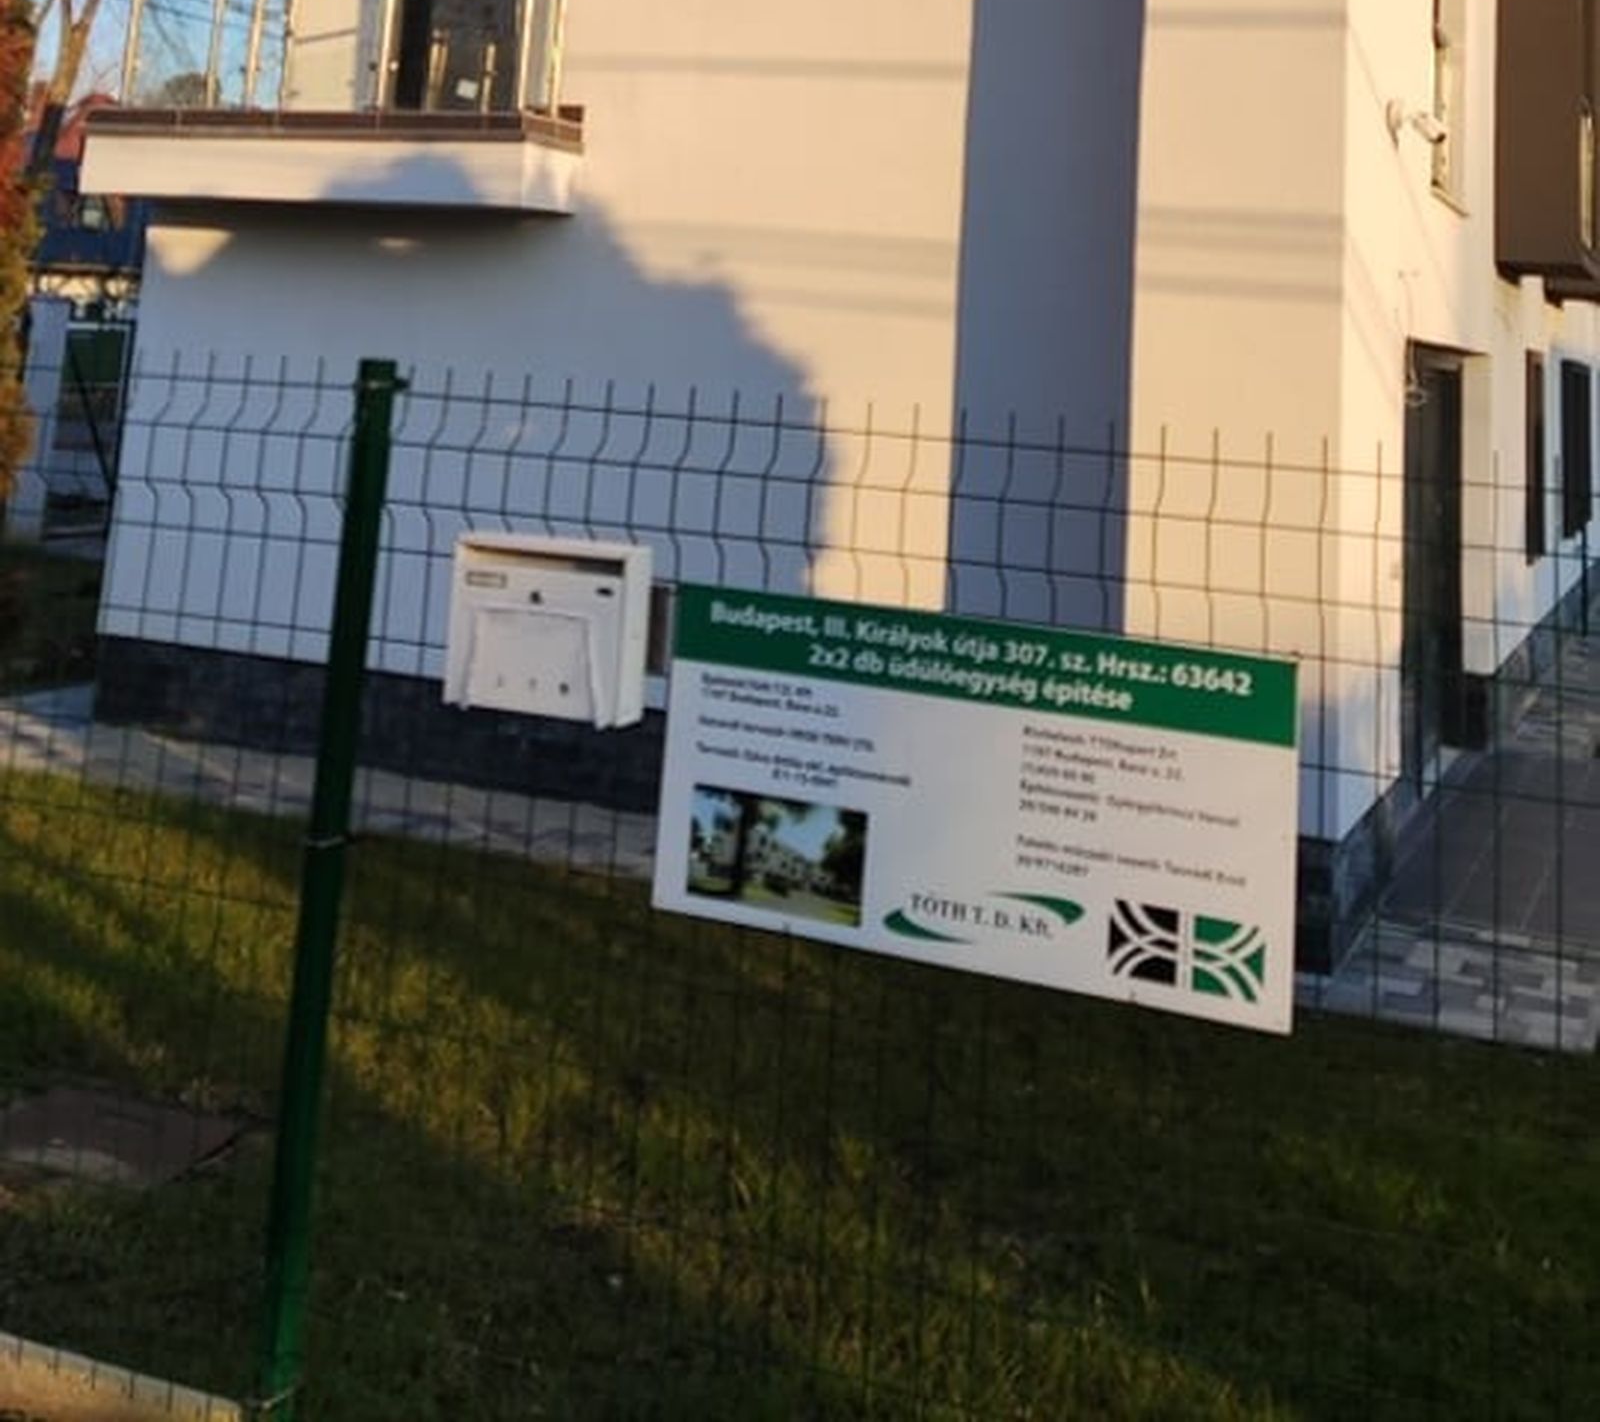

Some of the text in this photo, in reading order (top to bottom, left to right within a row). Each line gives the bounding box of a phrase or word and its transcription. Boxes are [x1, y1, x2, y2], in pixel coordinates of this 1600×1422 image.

[710, 600, 819, 638] Budapest,
[854, 617, 949, 655] Királyok
[951, 630, 998, 664] útja
[1060, 650, 1092, 673] sz.
[1170, 661, 1254, 697] 63642
[808, 642, 850, 670] 2x2
[852, 648, 885, 675] db
